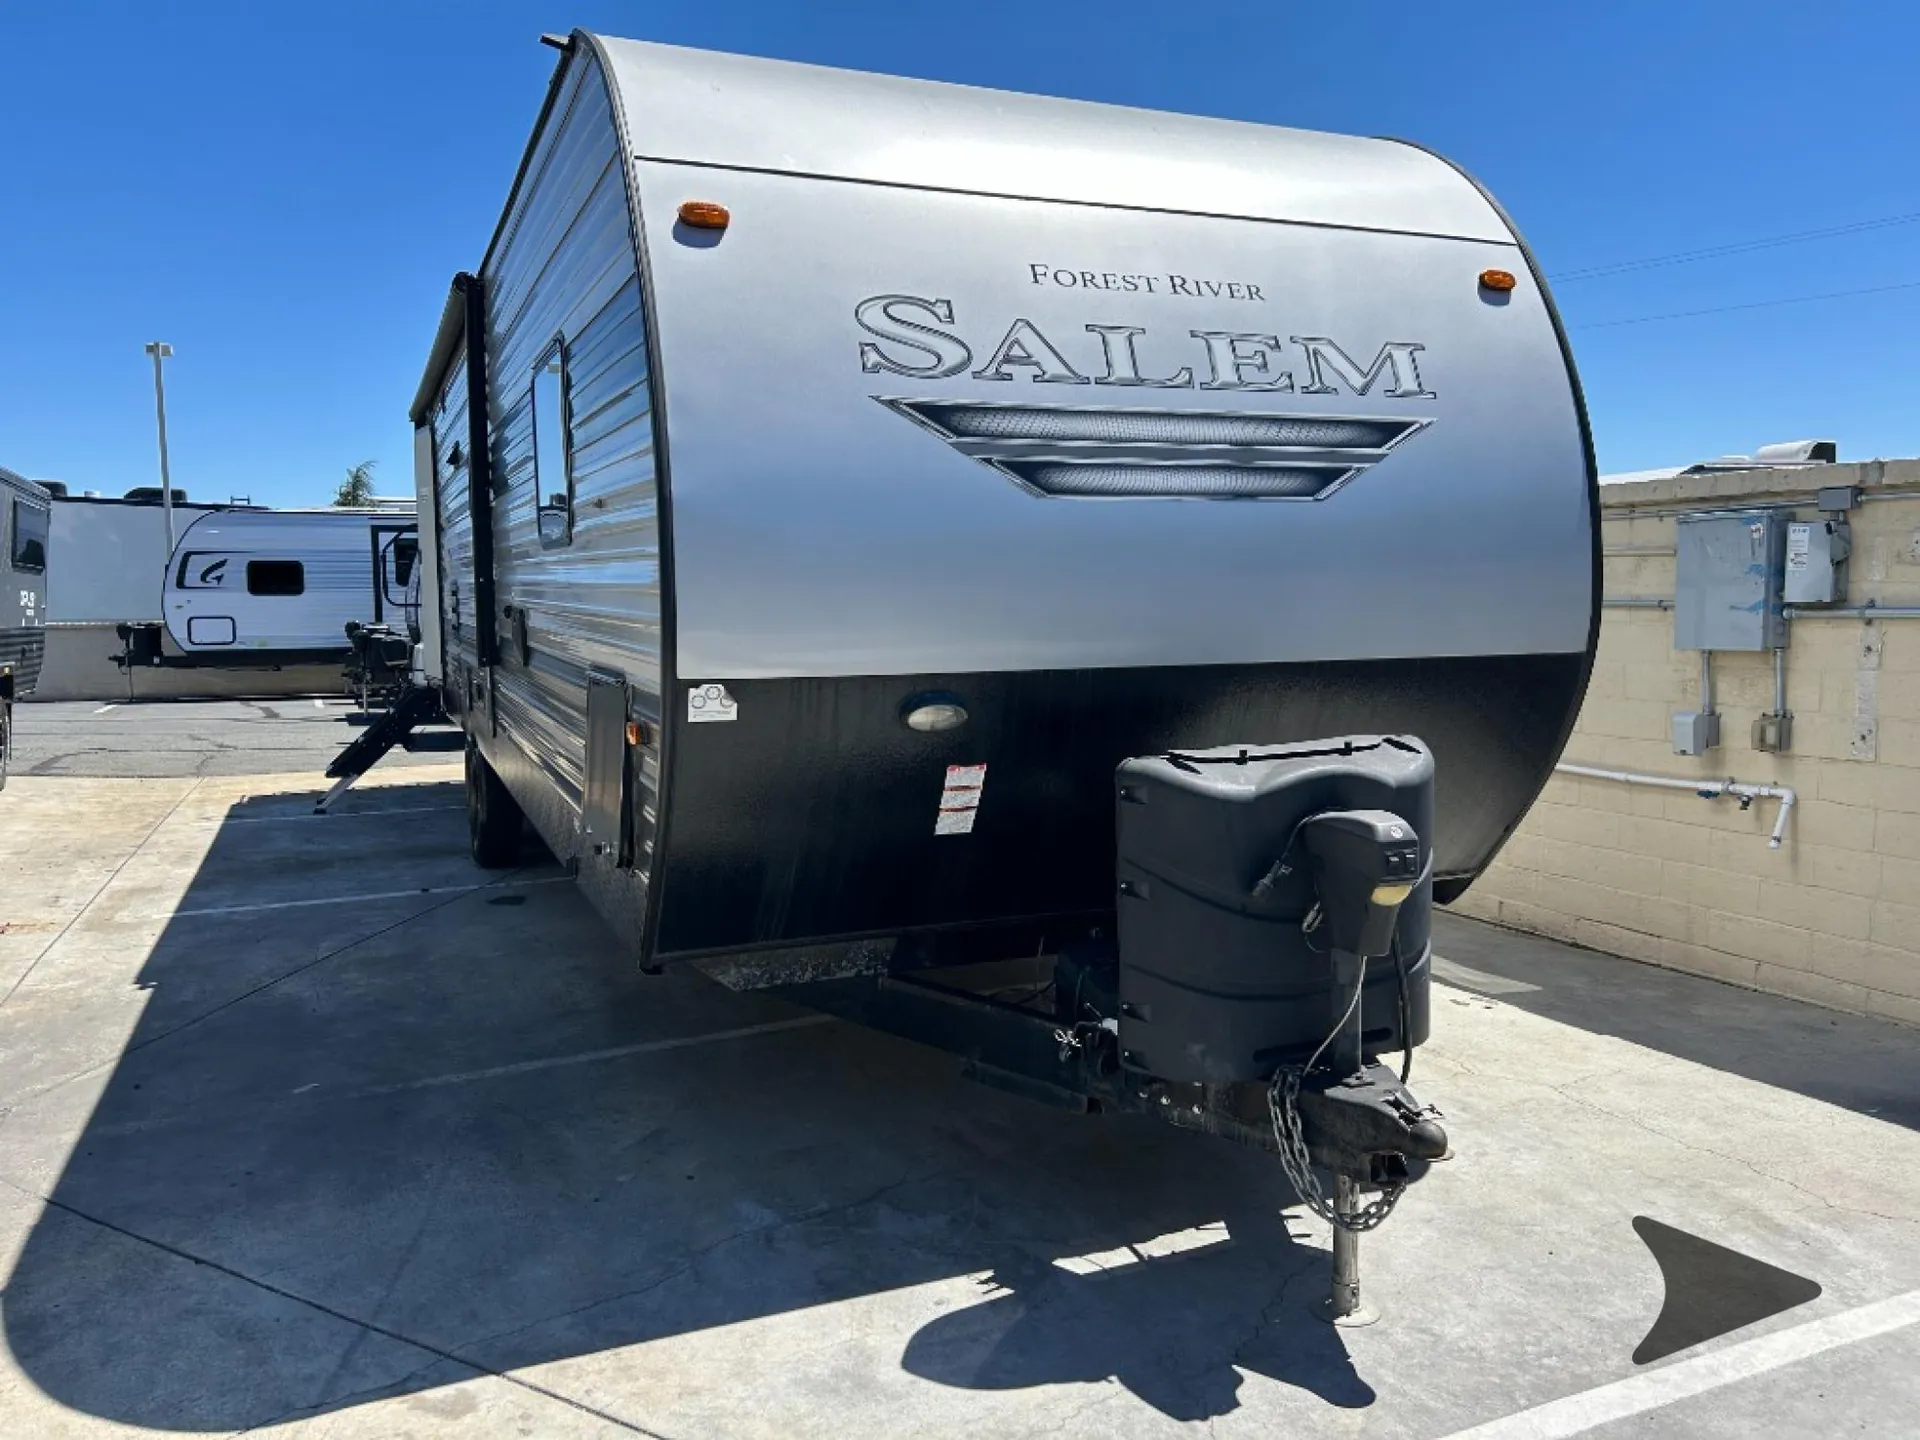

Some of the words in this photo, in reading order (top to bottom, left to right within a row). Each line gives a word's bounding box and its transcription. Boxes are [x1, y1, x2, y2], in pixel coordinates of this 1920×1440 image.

[1029, 263, 1159, 294] FOREST
[1168, 273, 1266, 301] RIVER
[854, 294, 1437, 399] SALEM
